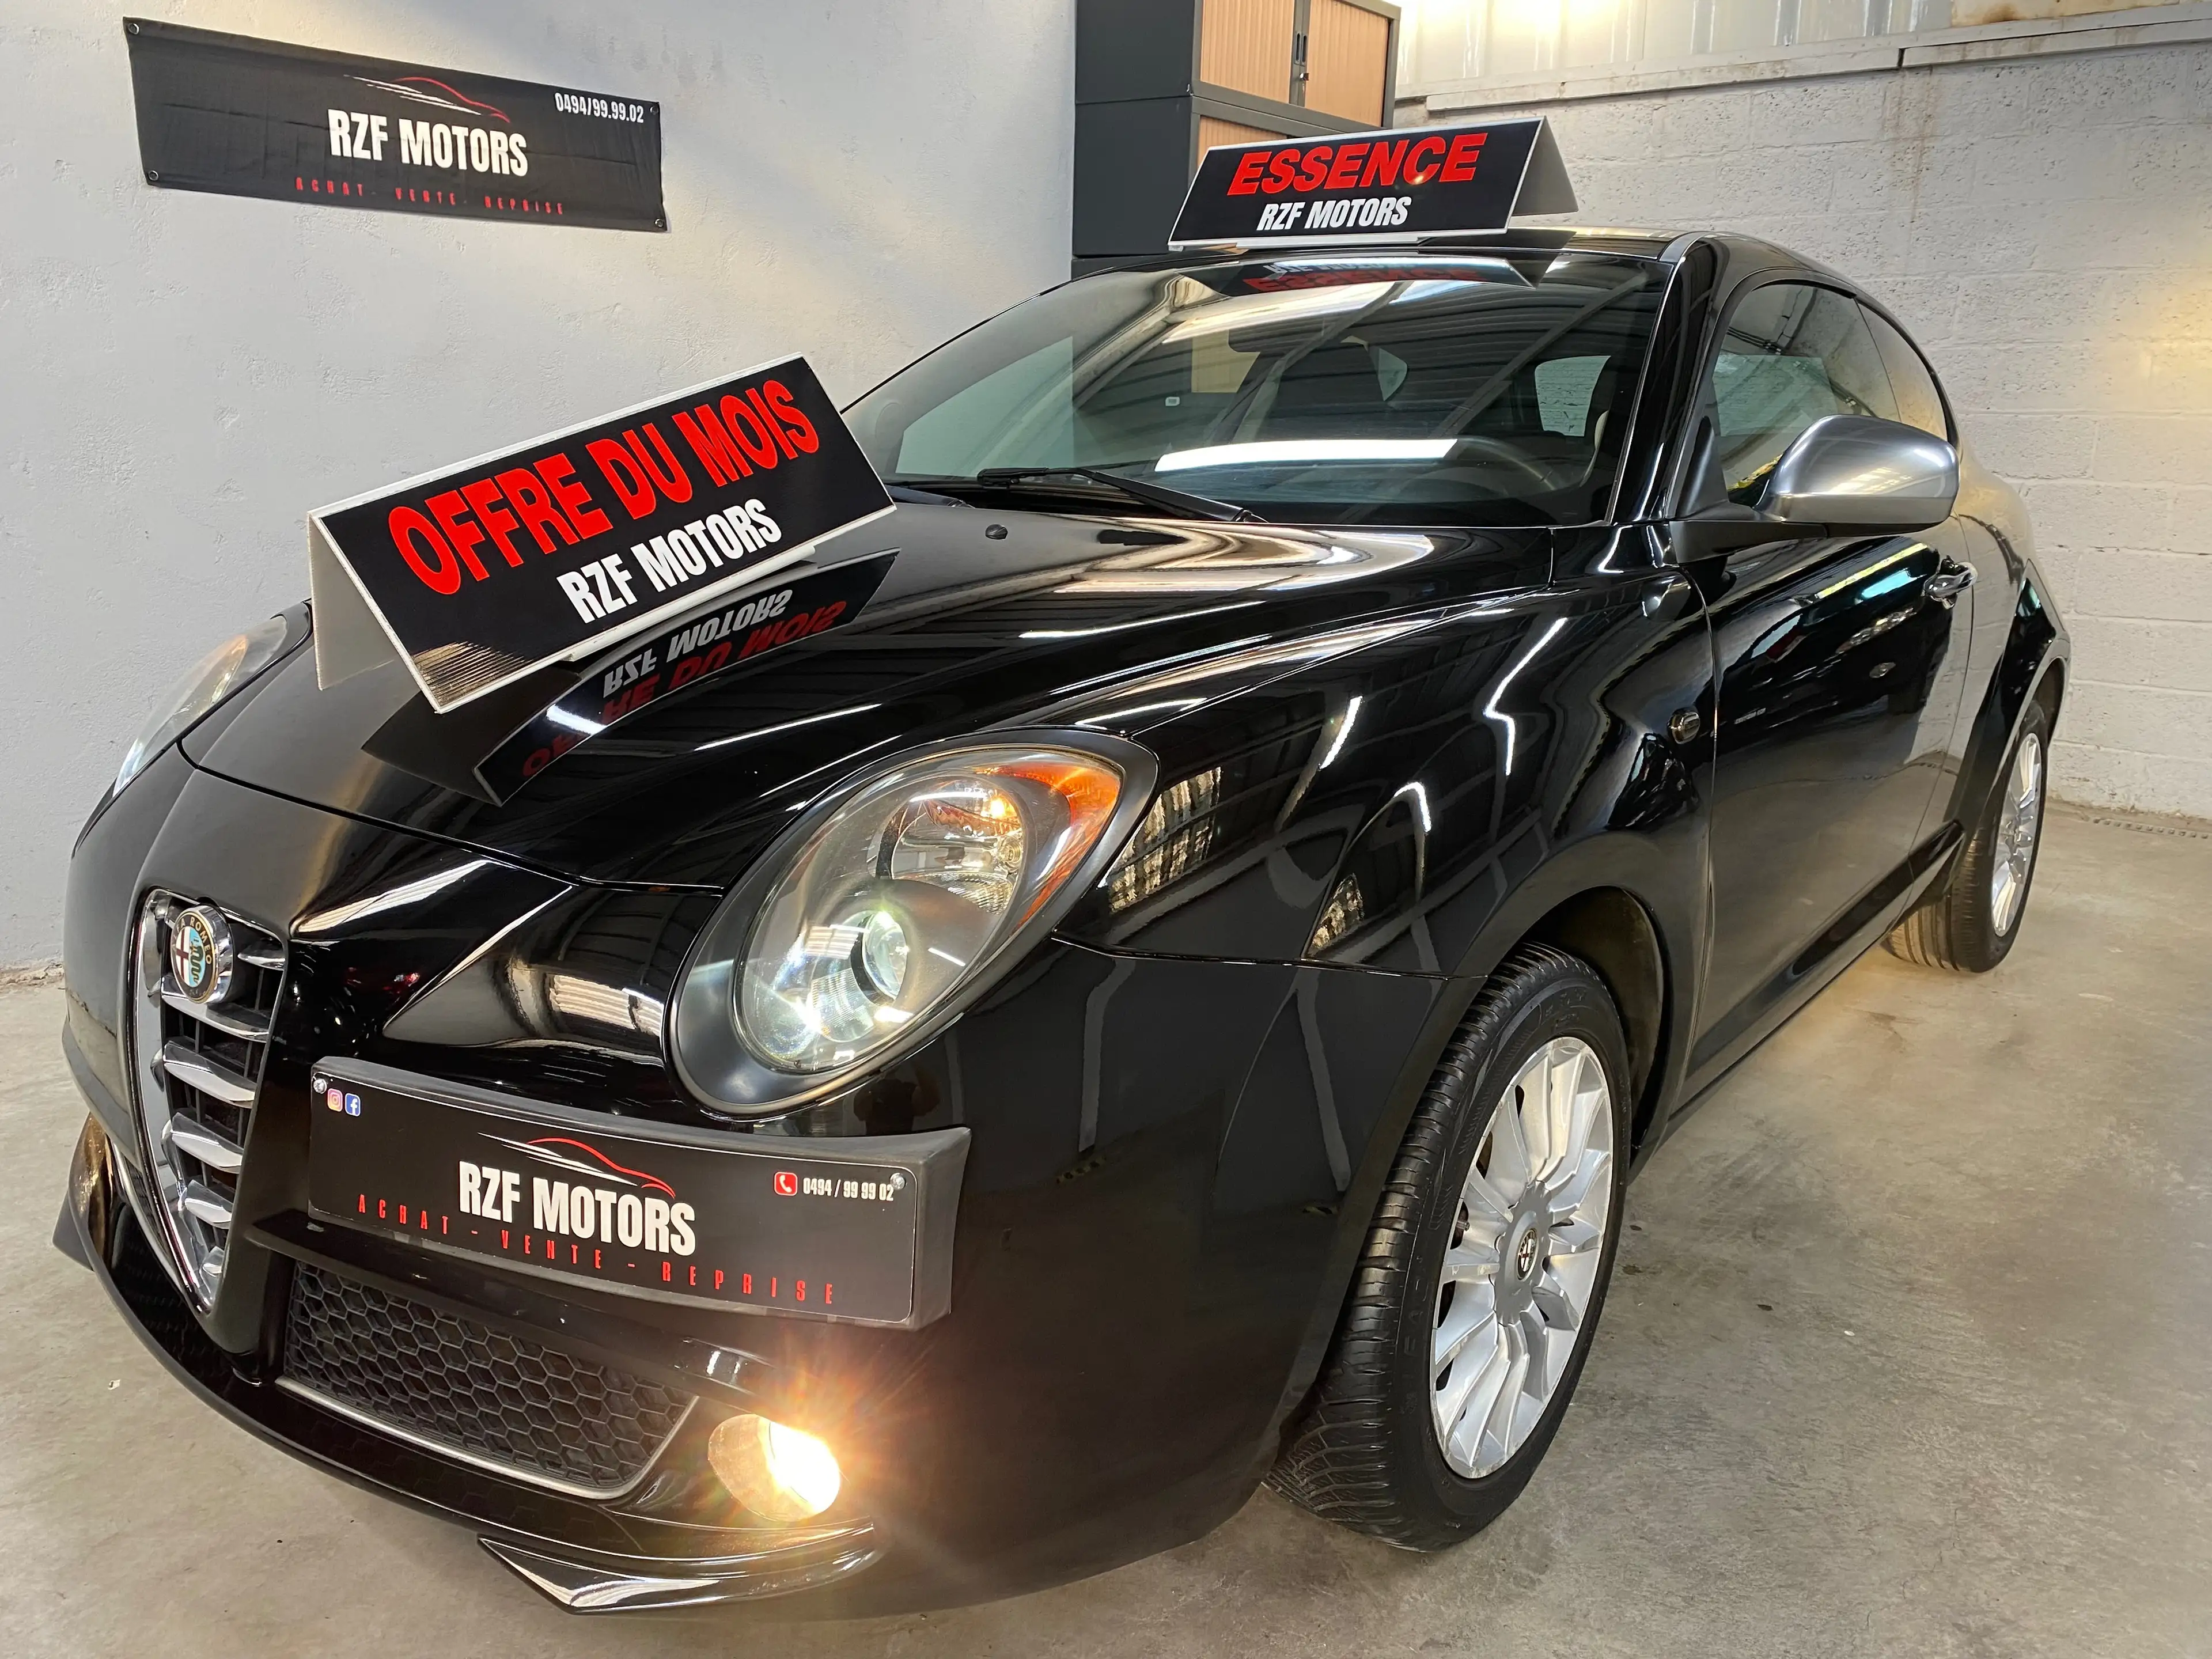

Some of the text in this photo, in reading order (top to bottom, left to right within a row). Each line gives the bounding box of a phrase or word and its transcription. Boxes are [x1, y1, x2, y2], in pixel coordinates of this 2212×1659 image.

[555, 92, 644, 123] 0494/99.99.02
[328, 109, 528, 177] RZF MOTORS
[1227, 132, 1488, 196] ESSENCE
[1257, 197, 1412, 230] RZF MOTORS
[388, 380, 820, 595] OFFRE DU MOIS
[556, 499, 782, 624] RZF MOTORS
[190, 916, 212, 964] ROMEO
[460, 1161, 696, 1256] RZF MOTORS
[803, 1177, 832, 1196] 0494
[843, 1181, 858, 1199] 99
[861, 1182, 876, 1200] 99
[878, 1183, 894, 1202] 02
[358, 1194, 448, 1234] ACHAT
[501, 1229, 601, 1269] VENTE
[662, 1261, 833, 1305] REPRISE
